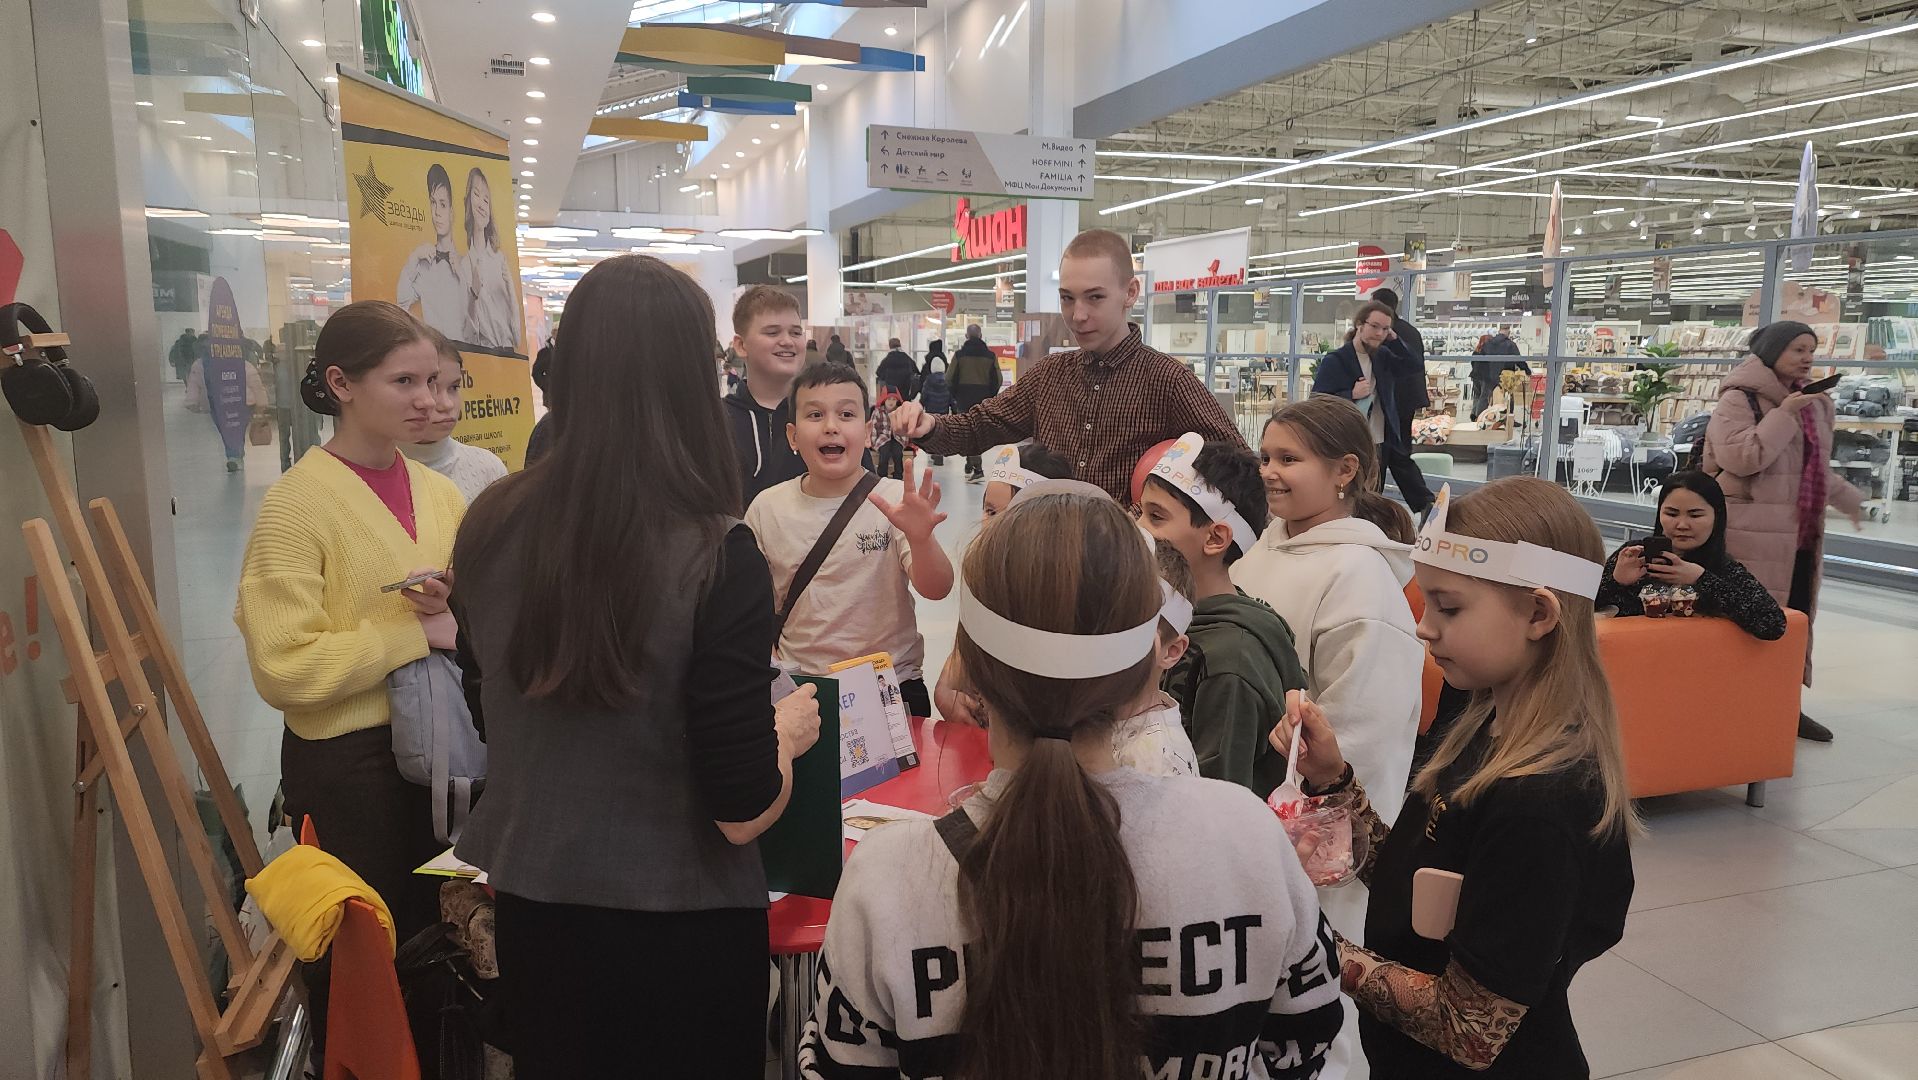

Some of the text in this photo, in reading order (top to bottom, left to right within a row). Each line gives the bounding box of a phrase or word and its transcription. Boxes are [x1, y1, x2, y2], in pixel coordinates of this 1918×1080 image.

[896, 131, 968, 145] Снежная Королева
[1041, 142, 1074, 152] М.Видео
[896, 148, 929, 158] Детский
[1032, 158, 1073, 168] HOFF MINI
[1040, 172, 1073, 181] FAMILIA
[1004, 181, 1024, 190] МФЦ
[1040, 183, 1079, 192] Документы
[461, 370, 474, 389] ТЬ
[464, 394, 521, 420] РЕБЁНКА?
